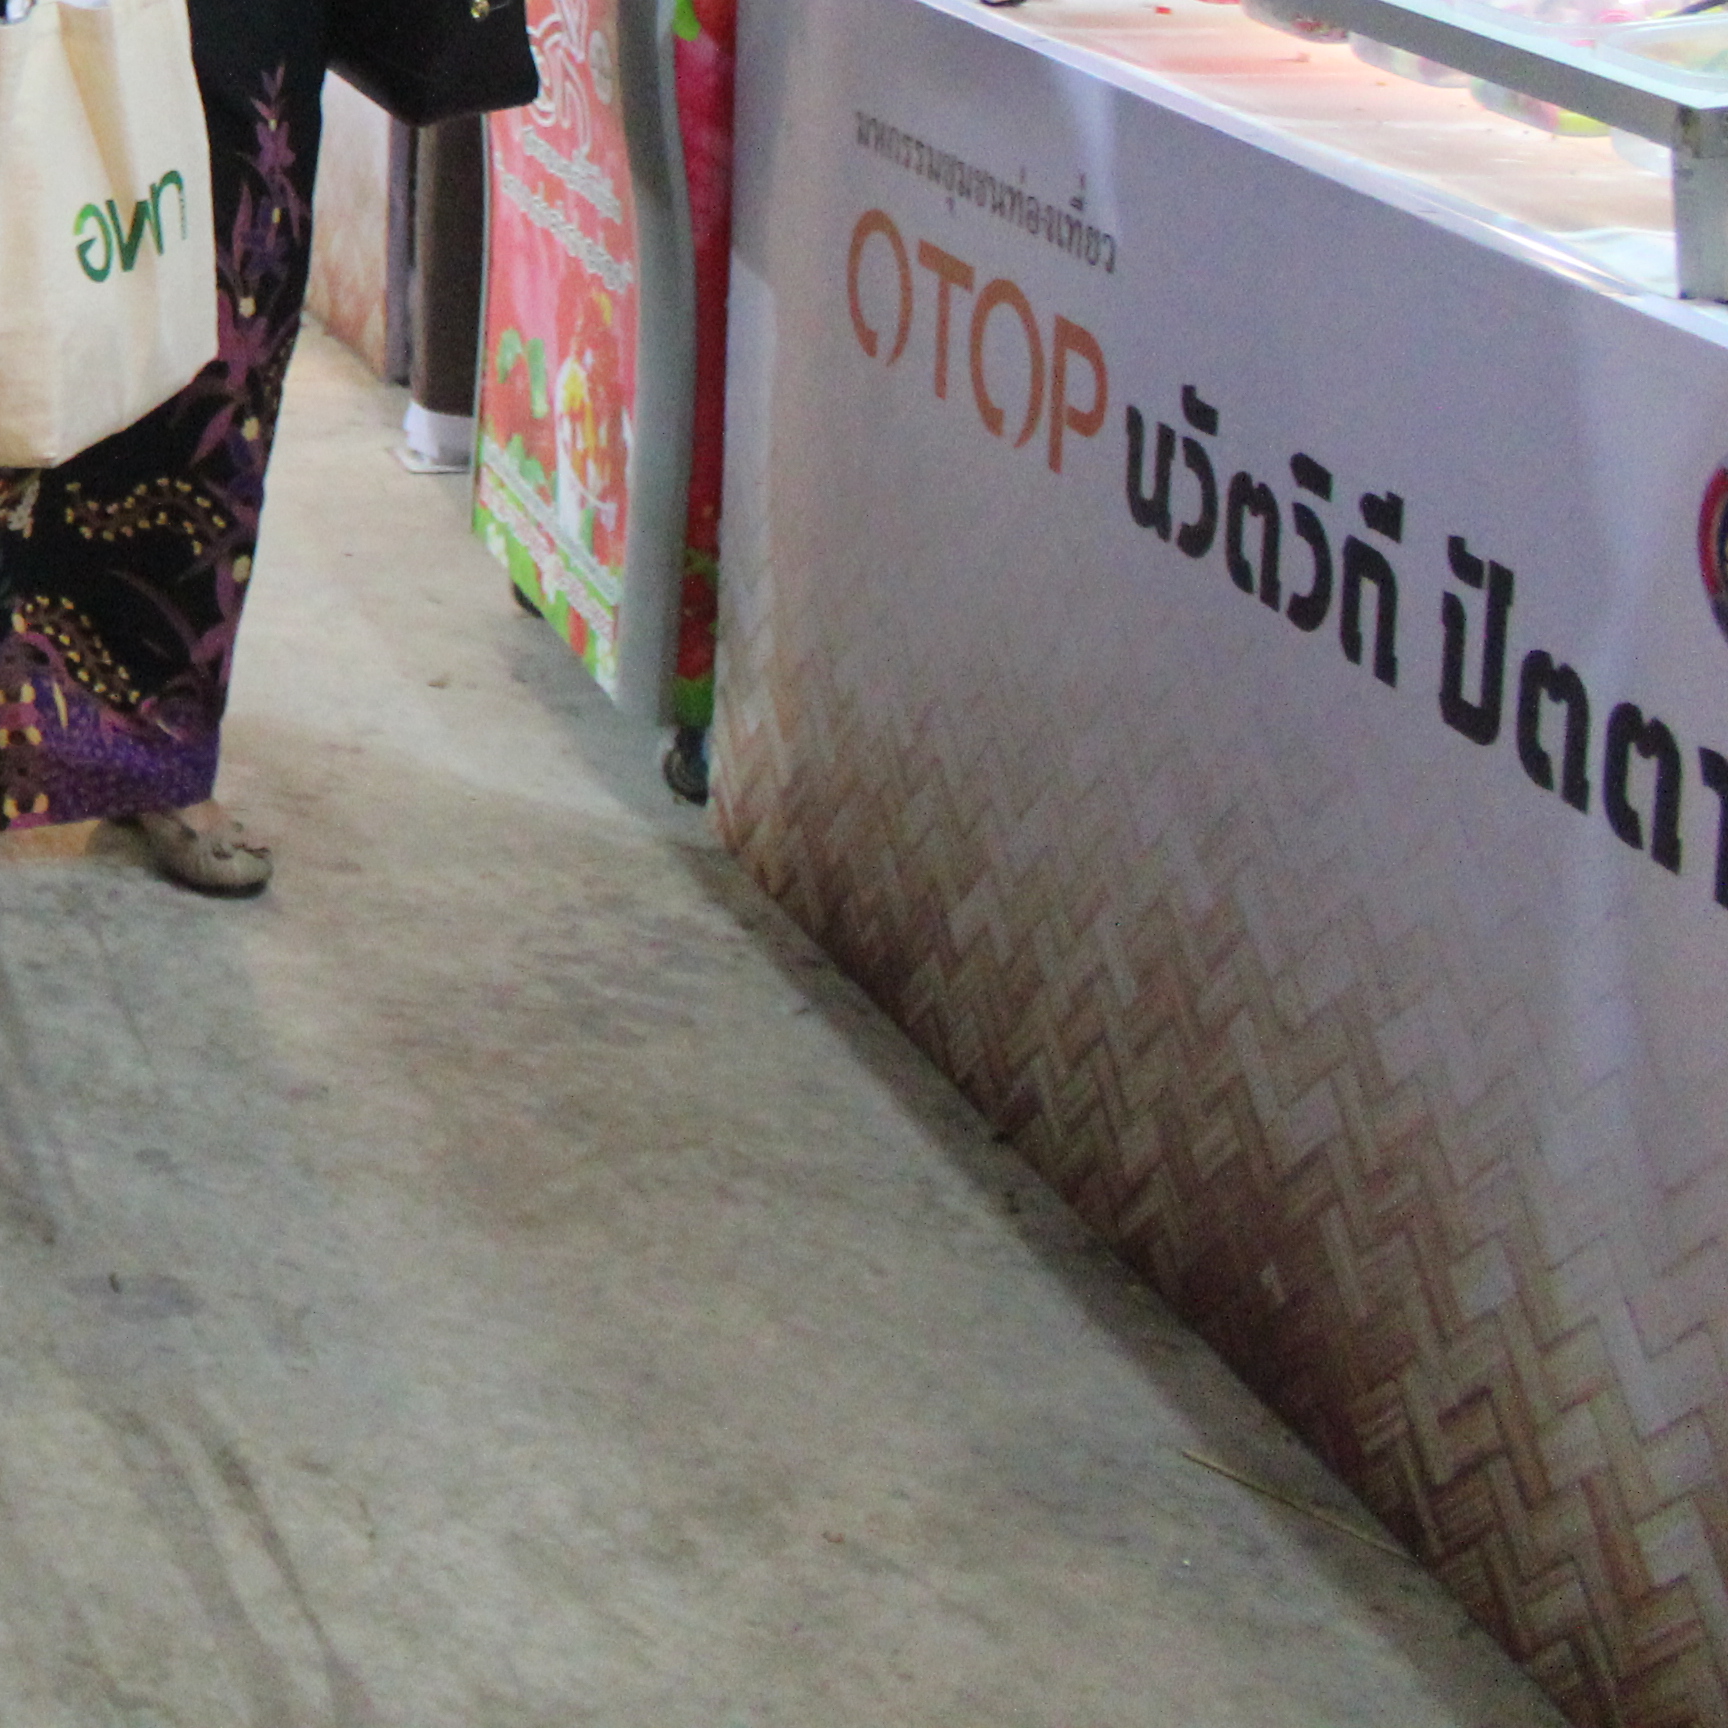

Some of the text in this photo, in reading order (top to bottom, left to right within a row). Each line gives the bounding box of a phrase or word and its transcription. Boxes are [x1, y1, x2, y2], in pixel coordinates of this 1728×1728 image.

[847, 208, 1110, 473] OTOP
[1123, 384, 1405, 688] นวัตวิถี
